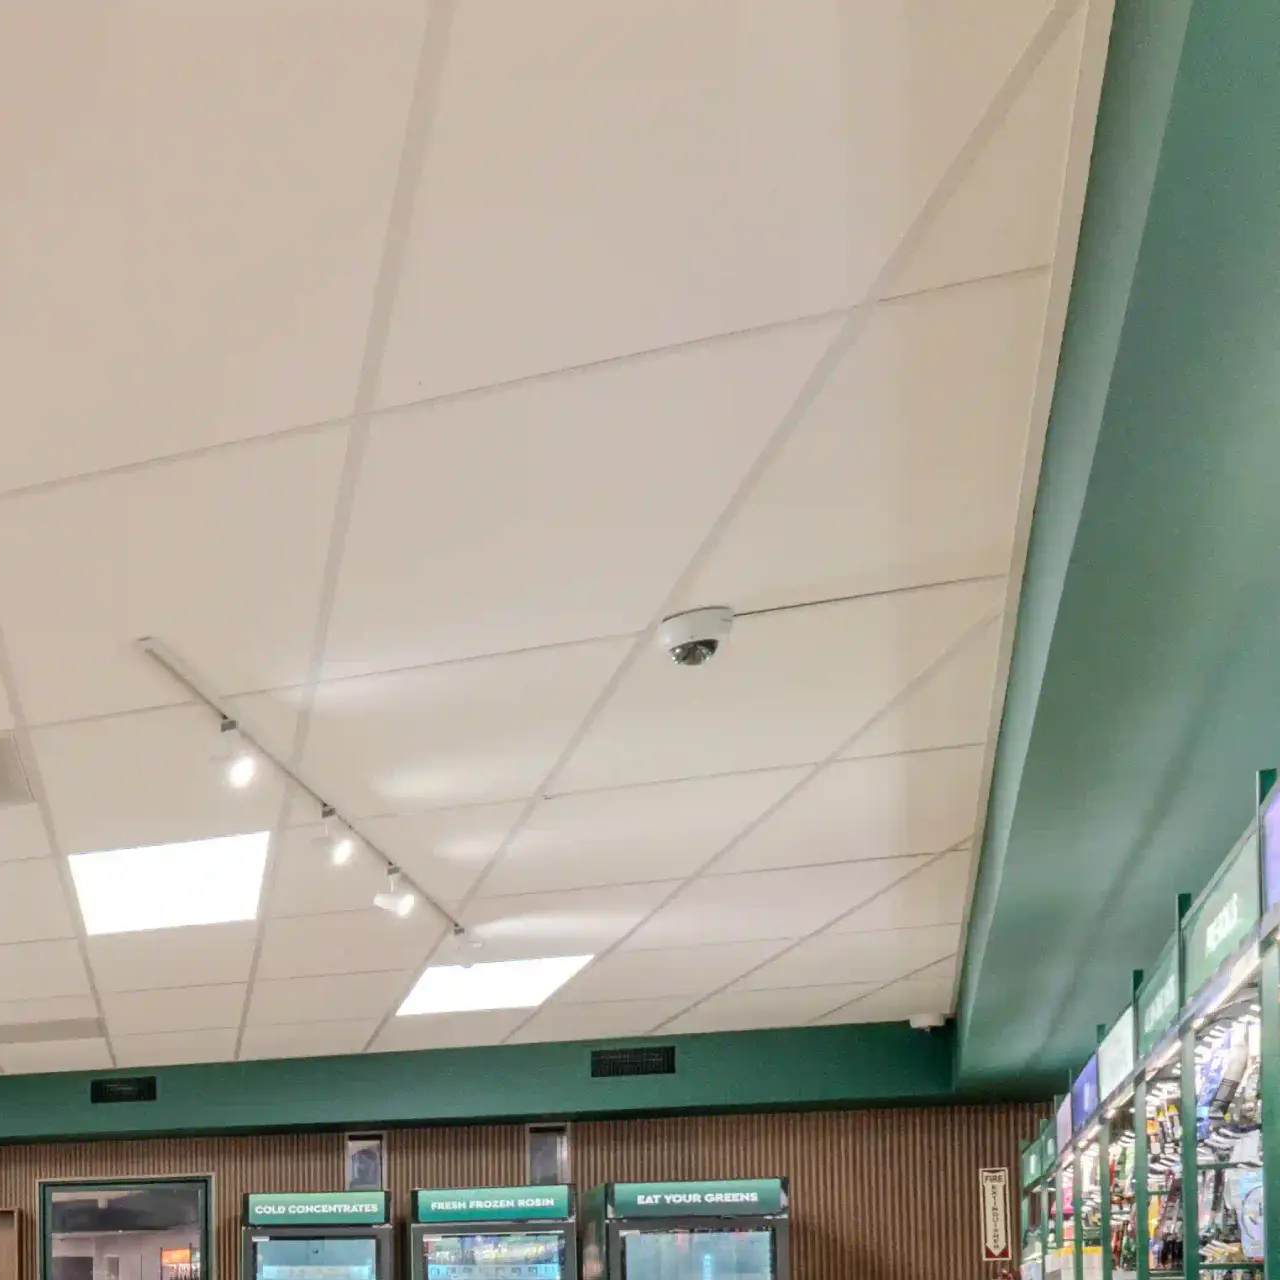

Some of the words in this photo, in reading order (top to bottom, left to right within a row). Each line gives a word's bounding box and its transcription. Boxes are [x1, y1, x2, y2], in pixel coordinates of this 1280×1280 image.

[431, 1200, 466, 1210] FRESH
[469, 1199, 515, 1209] FROZEN
[518, 1198, 554, 1208] ROSIN
[636, 1194, 661, 1205] EAT
[663, 1192, 702, 1204] YOUR
[704, 1192, 758, 1203] GREENS
[254, 1205, 286, 1214] COLD
[288, 1203, 378, 1214] CONCENTRATES
